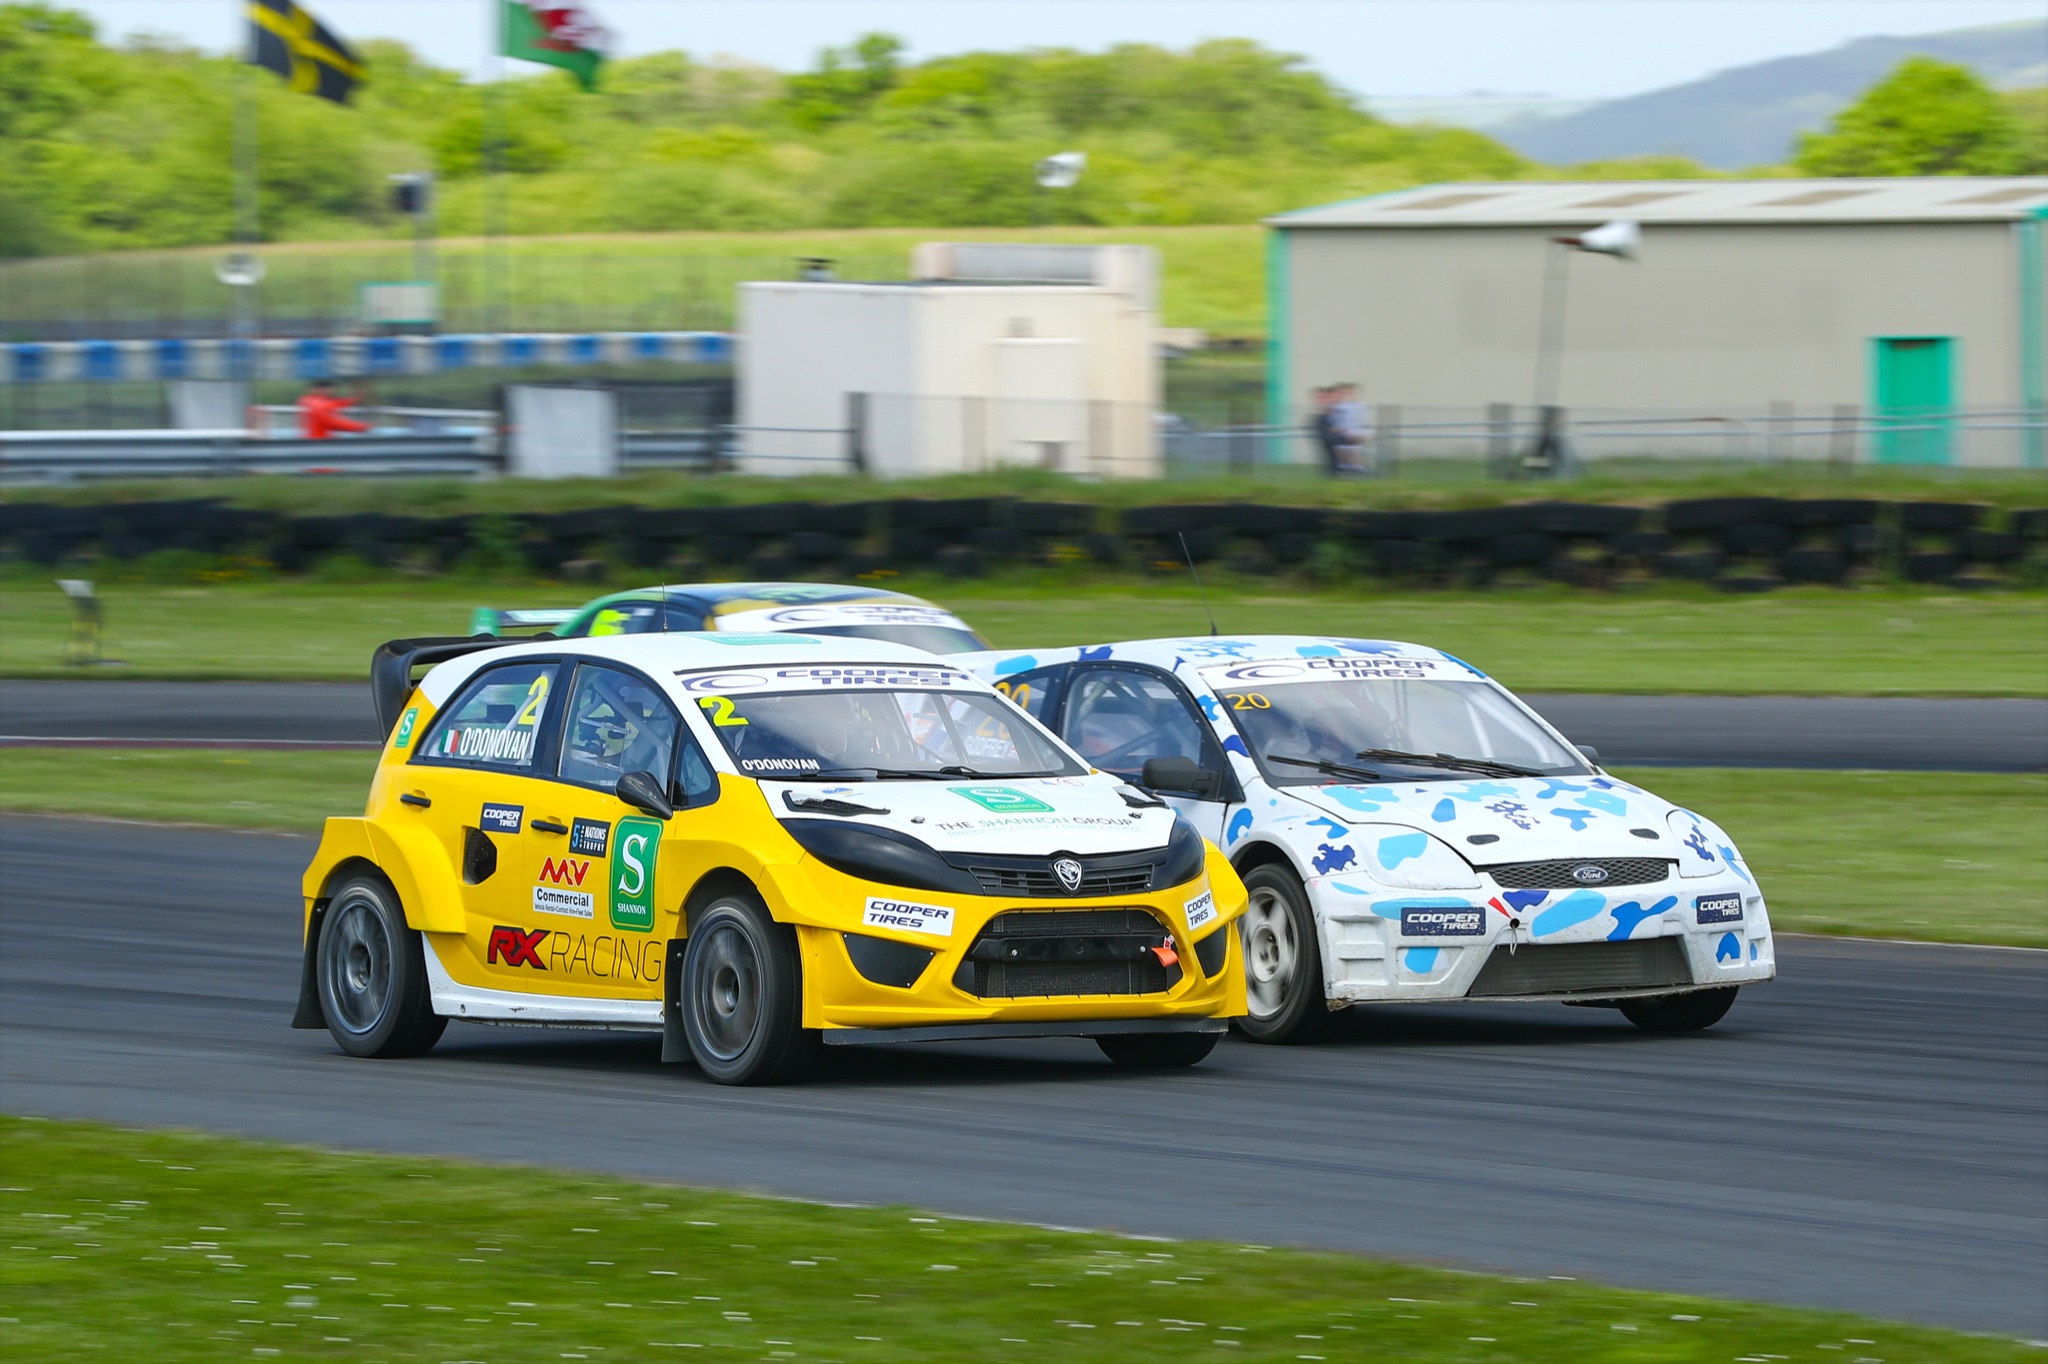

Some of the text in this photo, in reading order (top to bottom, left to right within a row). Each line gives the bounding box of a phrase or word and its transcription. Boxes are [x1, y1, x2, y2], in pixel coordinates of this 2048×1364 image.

[1307, 659, 1436, 670] COOPER
[777, 669, 969, 681] COOPER
[1333, 669, 1426, 678] TIRES
[811, 677, 951, 686] TIRES
[518, 676, 549, 725] 2
[1225, 692, 1272, 711] 20
[700, 695, 749, 727] 2
[460, 727, 532, 760] O'DONOVAN
[742, 758, 821, 771] O'DONOVAN
[483, 809, 520, 820] COOPER
[499, 819, 518, 828] TIRES
[935, 820, 974, 831] THE
[978, 816, 1069, 828] SHANNON
[1073, 817, 1132, 826] GROUP
[572, 824, 580, 848] 5
[584, 825, 607, 841] NATIONS
[583, 840, 605, 852] TROPHY
[617, 833, 649, 898] S
[1582, 869, 1601, 879] Ford
[536, 888, 589, 907] Commercial
[1187, 893, 1211, 913] COOPER
[1700, 898, 1740, 911] COOPER
[617, 902, 647, 915] SHANNON
[870, 900, 949, 919] COOPER
[1722, 908, 1740, 916] TIRES
[869, 912, 924, 928] TIRES
[1190, 908, 1209, 926] TIRES
[1406, 913, 1481, 923] COOPER
[1442, 922, 1480, 930] TIRES
[487, 925, 663, 982] RX RACING
